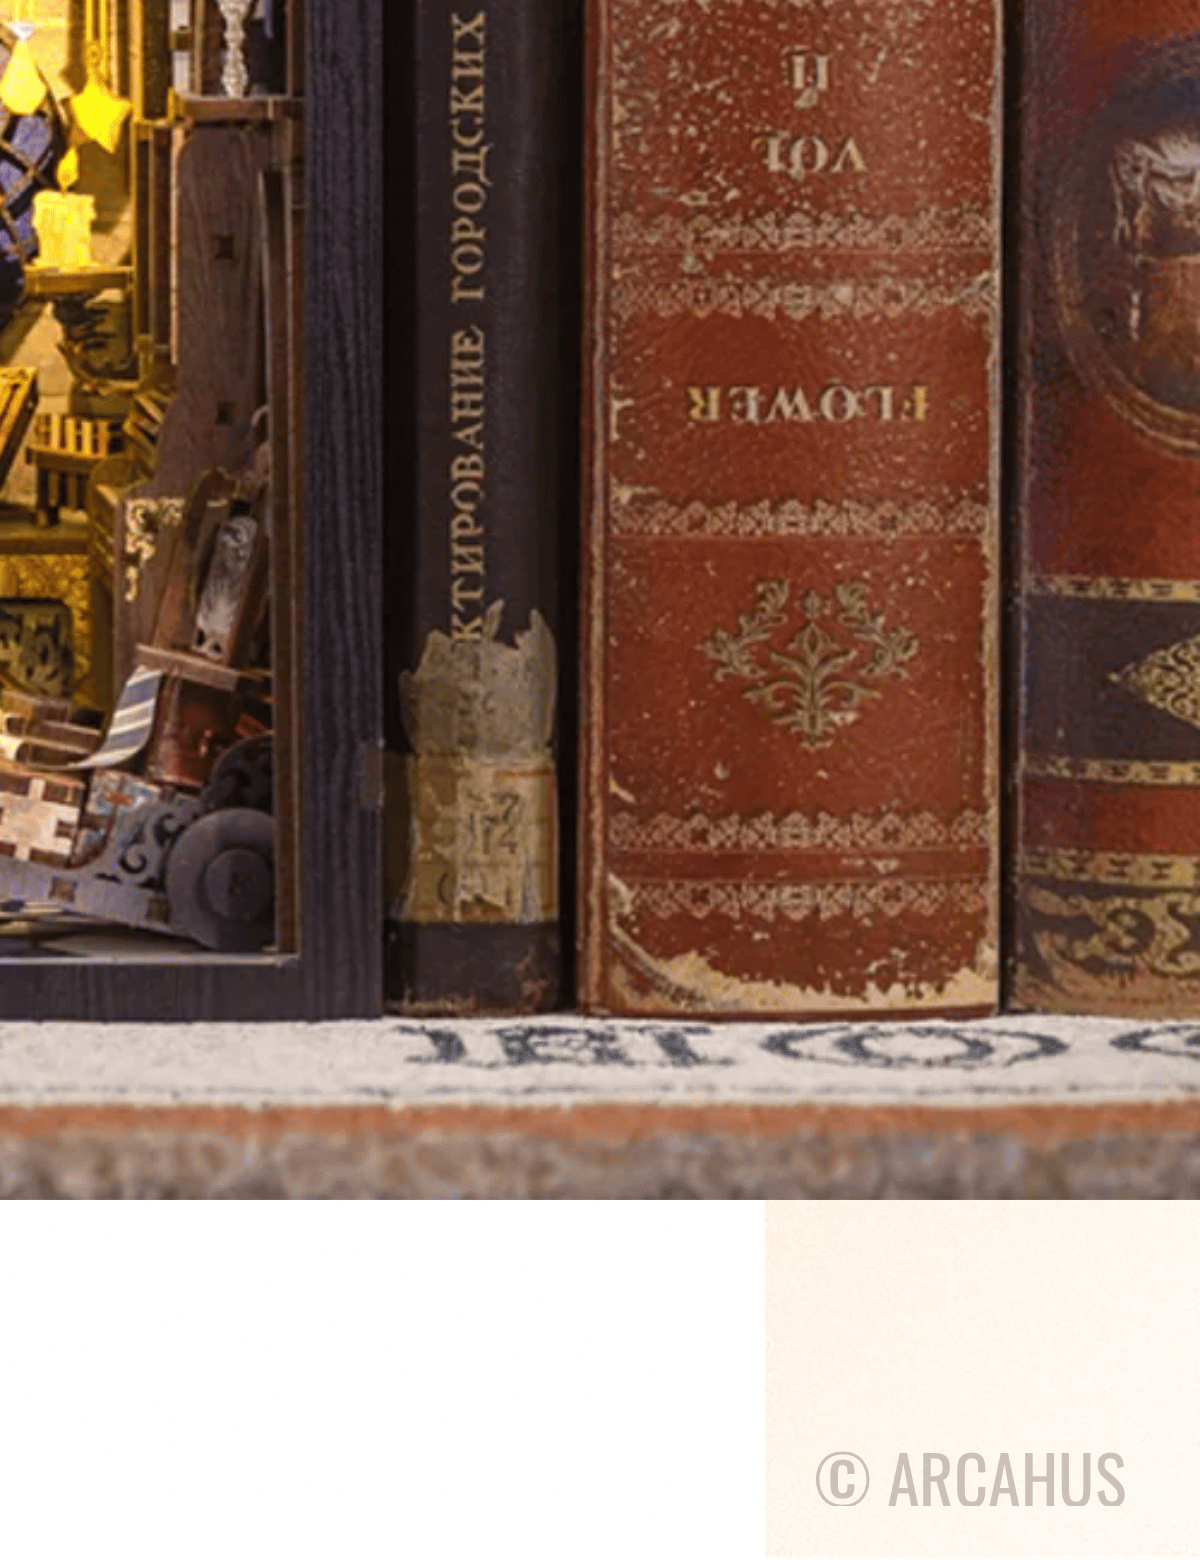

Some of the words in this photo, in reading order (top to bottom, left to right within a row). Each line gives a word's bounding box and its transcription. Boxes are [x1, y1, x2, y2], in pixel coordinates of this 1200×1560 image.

[449, 9, 493, 304] ГОРОДСКИХ
[751, 134, 867, 174] VOL
[449, 323, 486, 641] КТИРОВАНИЕ
[686, 384, 929, 425] FLOWER
